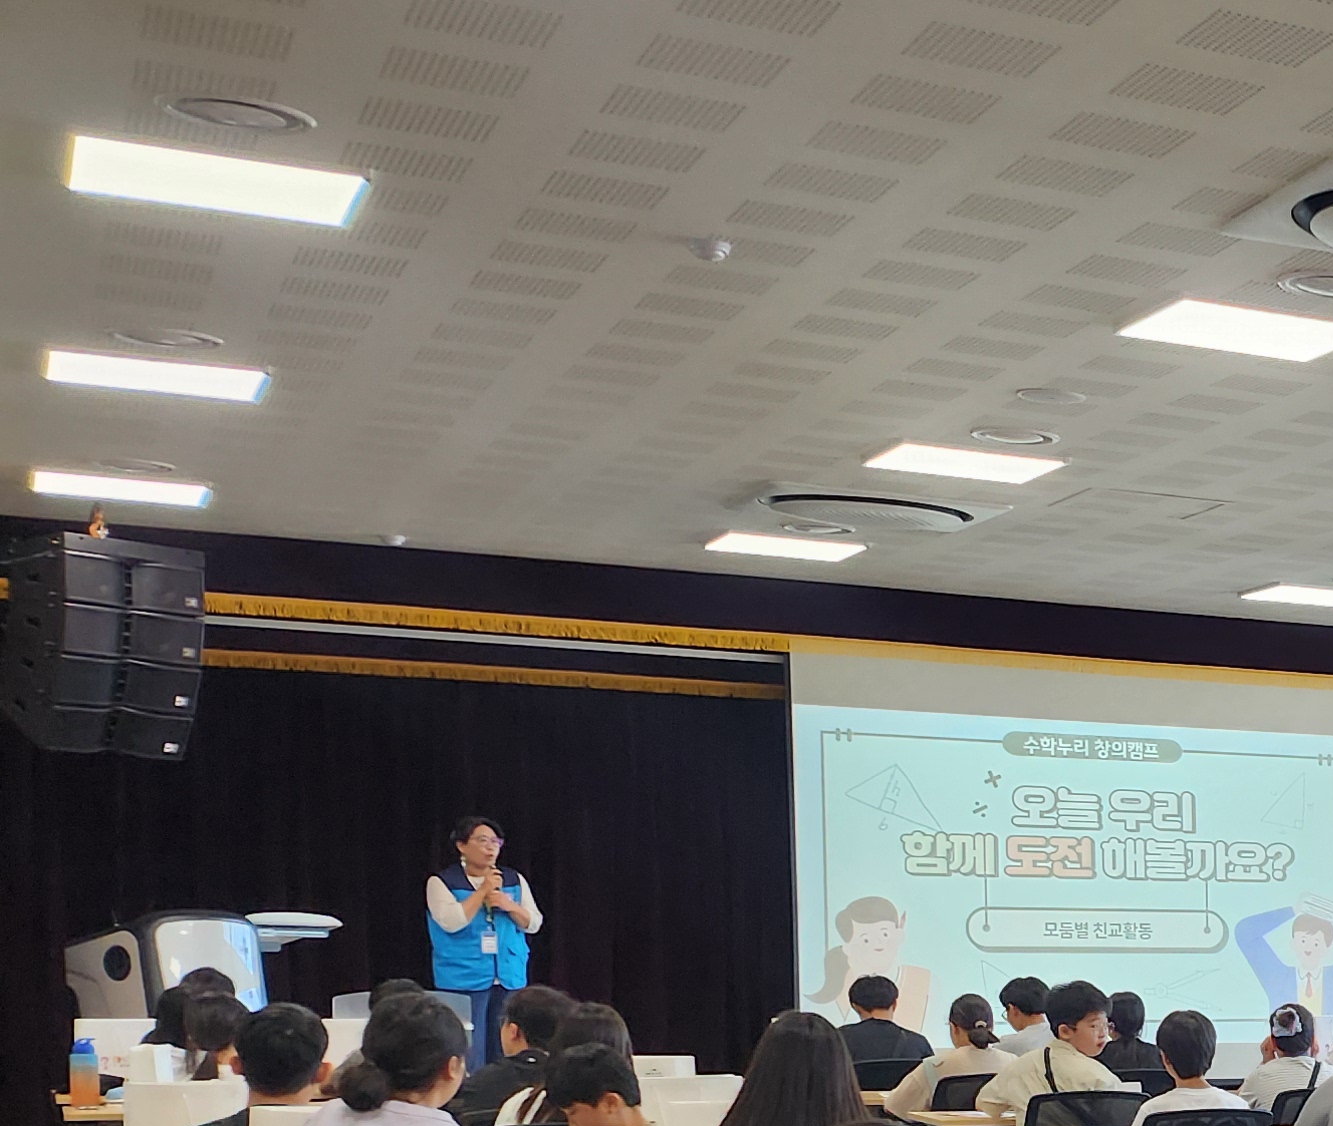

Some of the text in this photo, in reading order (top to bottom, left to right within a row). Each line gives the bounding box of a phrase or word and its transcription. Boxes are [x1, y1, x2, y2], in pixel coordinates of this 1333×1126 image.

[1022, 736, 1160, 760] 수학누리 창의캠프
[1011, 785, 1196, 834] 오늘 우리
[900, 831, 1294, 882] 함께 도전 해볼까요?
[1043, 919, 1154, 941] 모둠별 친교활동
